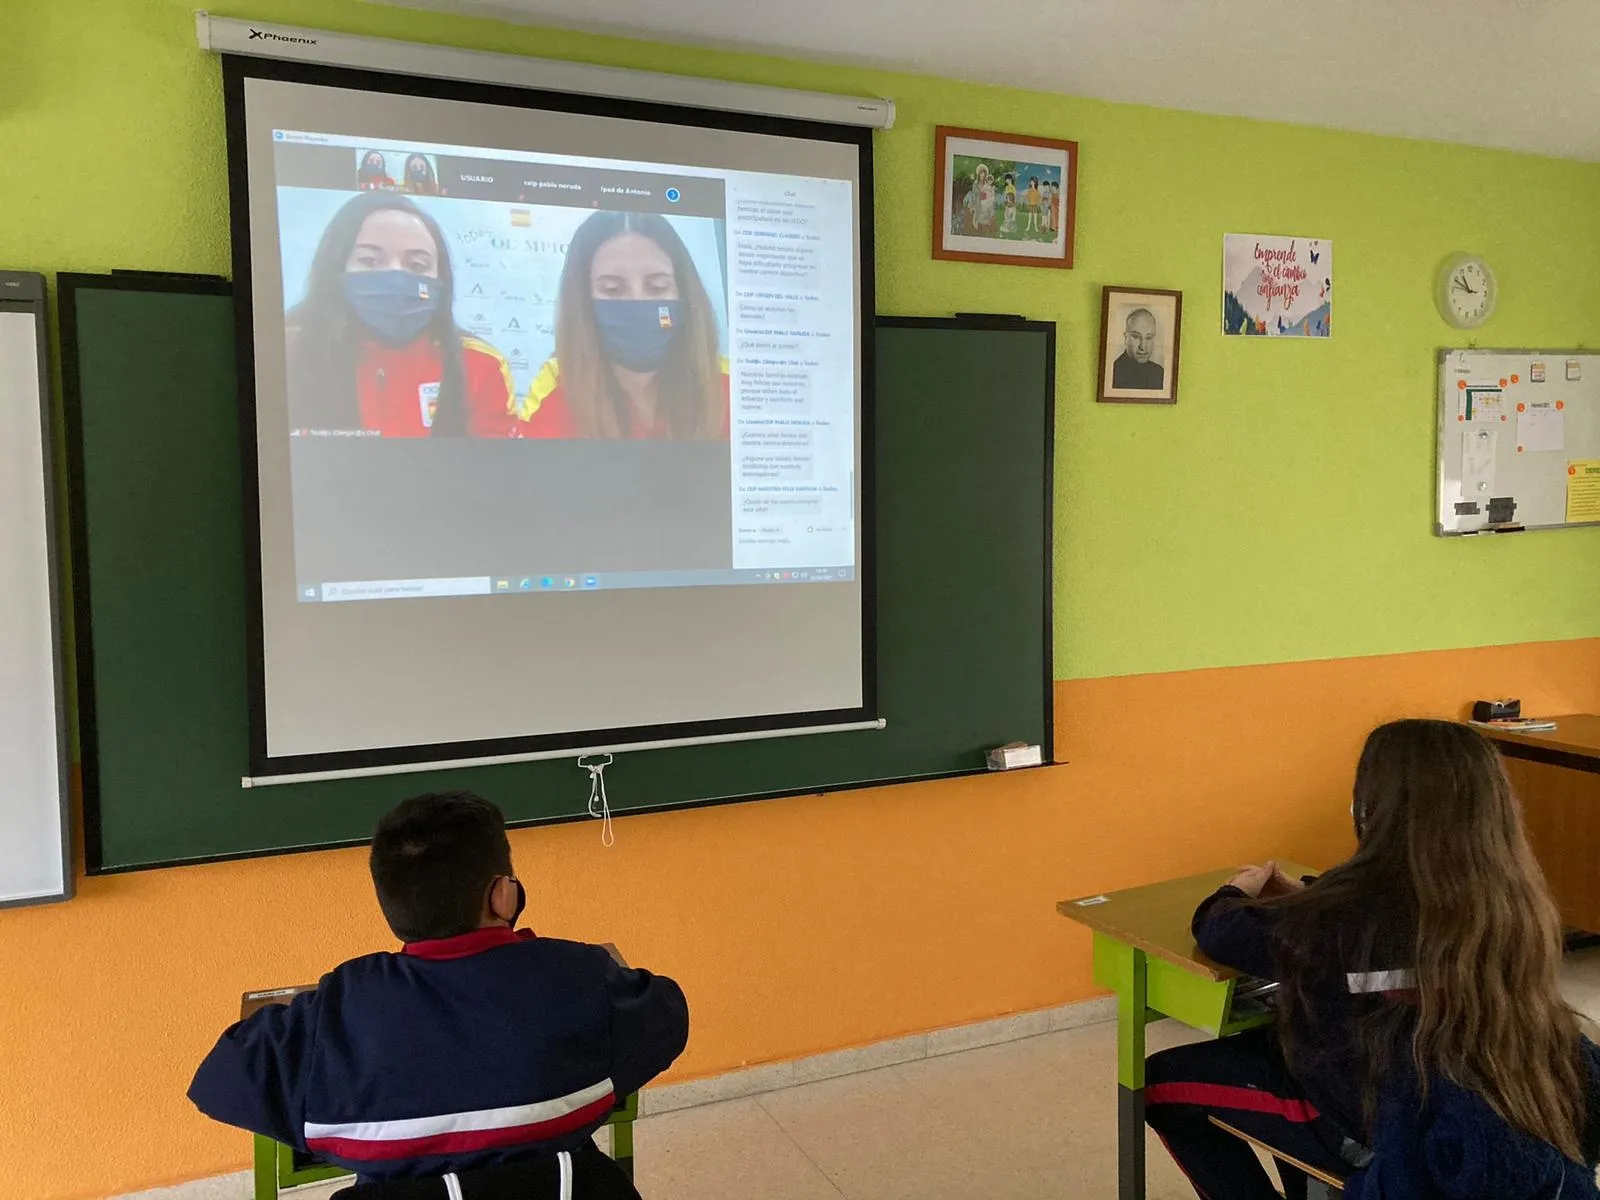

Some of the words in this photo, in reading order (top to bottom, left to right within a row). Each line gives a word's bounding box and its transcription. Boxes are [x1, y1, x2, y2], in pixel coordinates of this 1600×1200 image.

[460, 174, 494, 184] USUARIO
[539, 180, 557, 190] pablo
[558, 181, 582, 191] neruda
